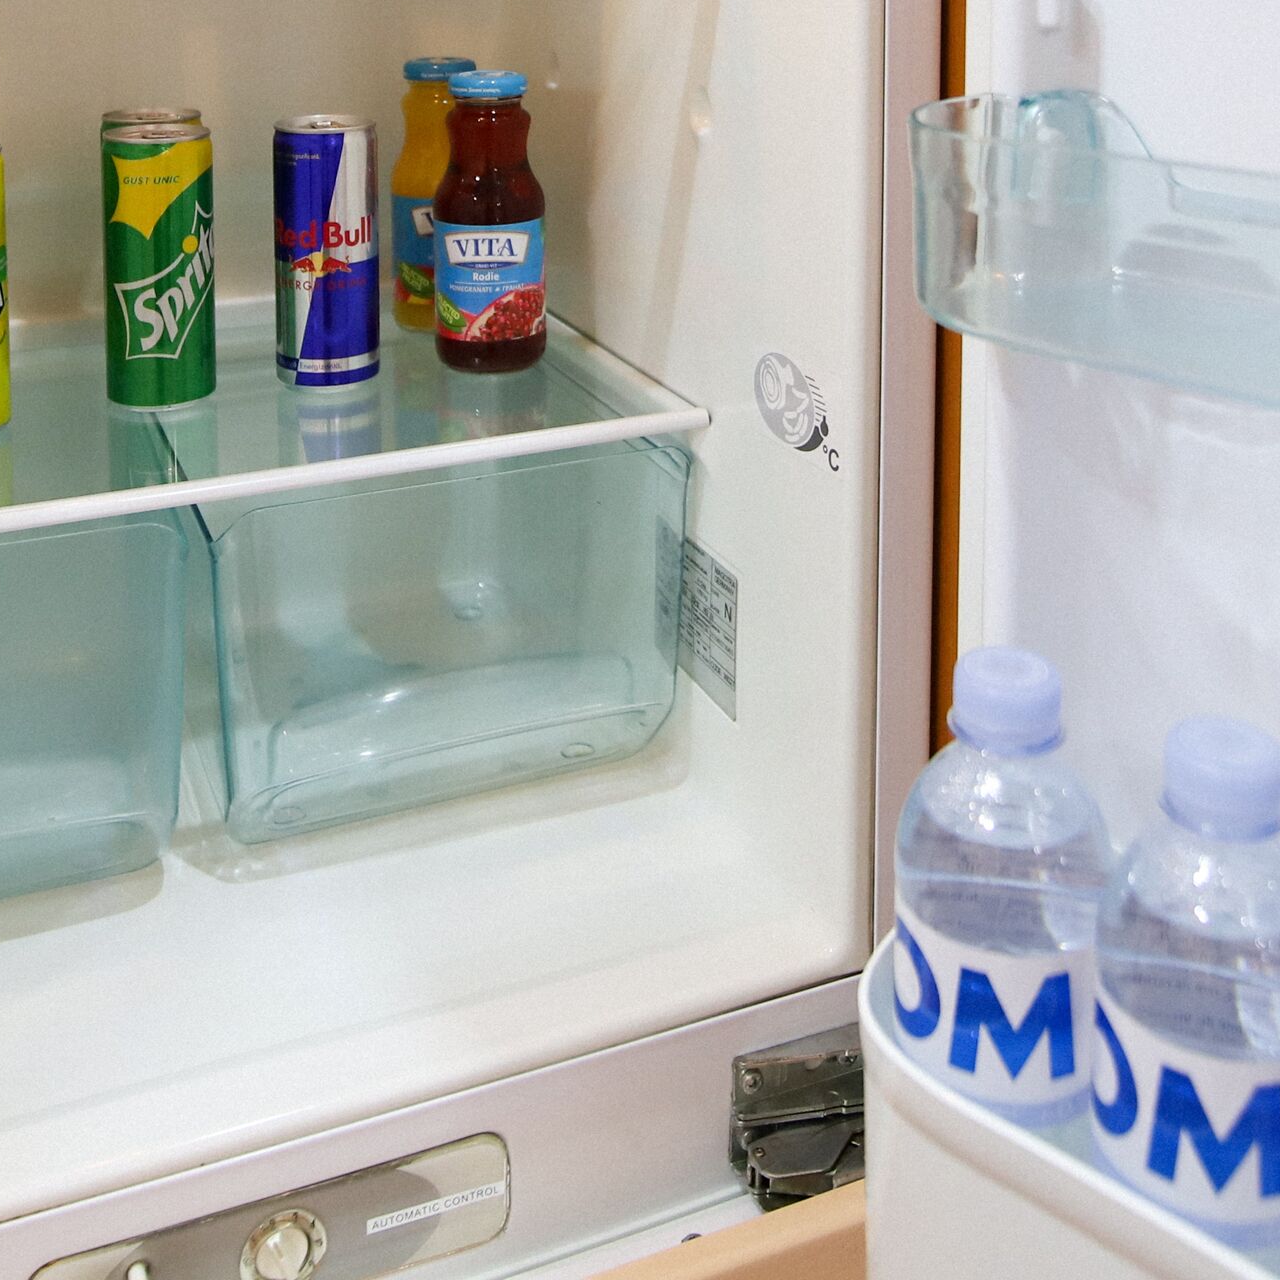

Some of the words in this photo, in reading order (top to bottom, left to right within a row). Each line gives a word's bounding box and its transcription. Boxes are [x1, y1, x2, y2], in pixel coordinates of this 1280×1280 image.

[123, 175, 150, 185] GUST
[153, 174, 181, 185] UNIC
[322, 213, 372, 249] Bull
[452, 238, 518, 257] VITA
[472, 272, 500, 282] Rodie
[822, 444, 840, 472] °C
[371, 1202, 441, 1231] AUTOMATIC
[443, 1185, 500, 1210] CONTROL
